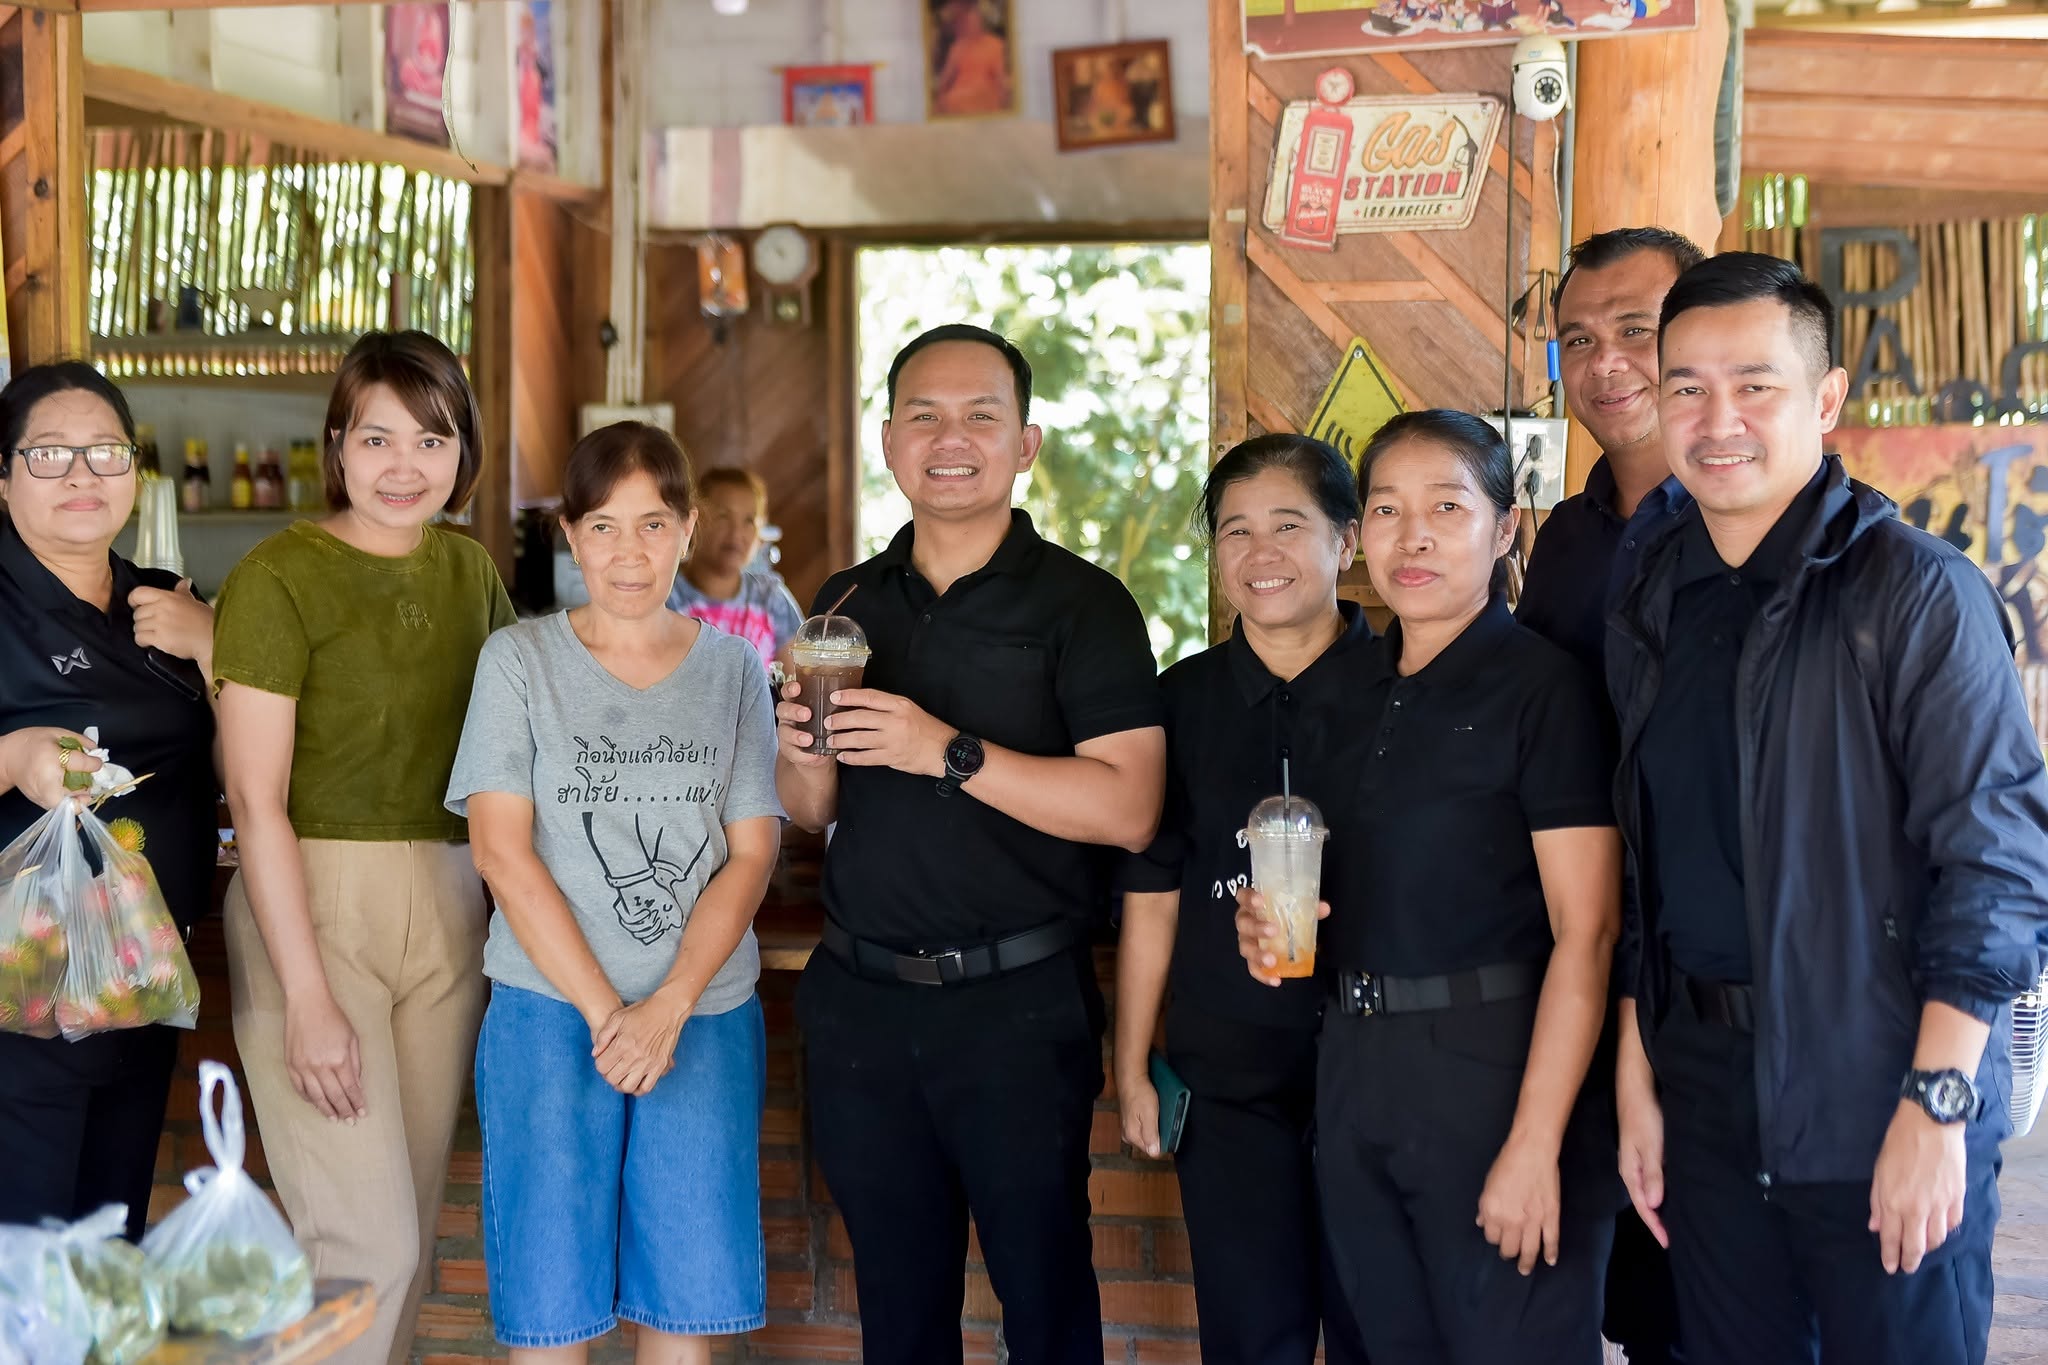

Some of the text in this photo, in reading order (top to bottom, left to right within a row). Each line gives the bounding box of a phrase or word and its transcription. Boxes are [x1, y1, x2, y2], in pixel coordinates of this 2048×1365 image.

[1361, 111, 1456, 173] Gas
[1344, 170, 1462, 200] STATION
[1363, 203, 1442, 218] LOS ANGELES
